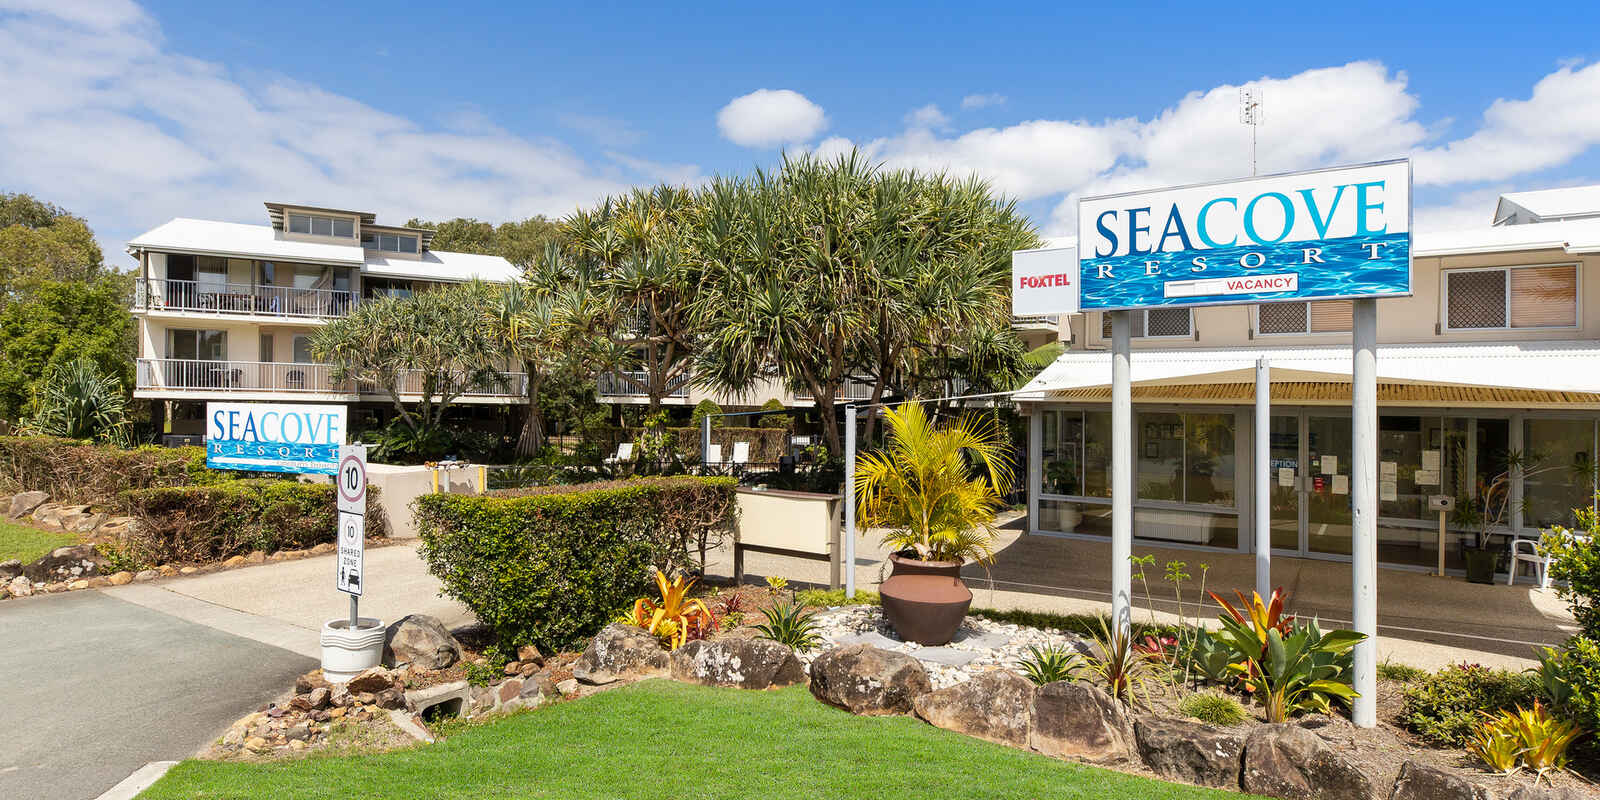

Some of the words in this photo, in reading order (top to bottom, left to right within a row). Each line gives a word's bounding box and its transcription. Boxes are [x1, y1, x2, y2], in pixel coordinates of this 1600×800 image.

[1095, 181, 1387, 258] SEACOVE
[1096, 243, 1386, 278] RESORT
[1019, 273, 1071, 290] FOXTEL
[1227, 276, 1292, 291] VACANCY
[213, 410, 339, 444] SEACOVE
[214, 445, 340, 459] RESORT
[1271, 459, 1298, 468] EPTION
[345, 466, 359, 490] 10
[347, 525, 355, 538] 10
[341, 546, 361, 558] SHARED
[343, 557, 357, 567] ZONE
